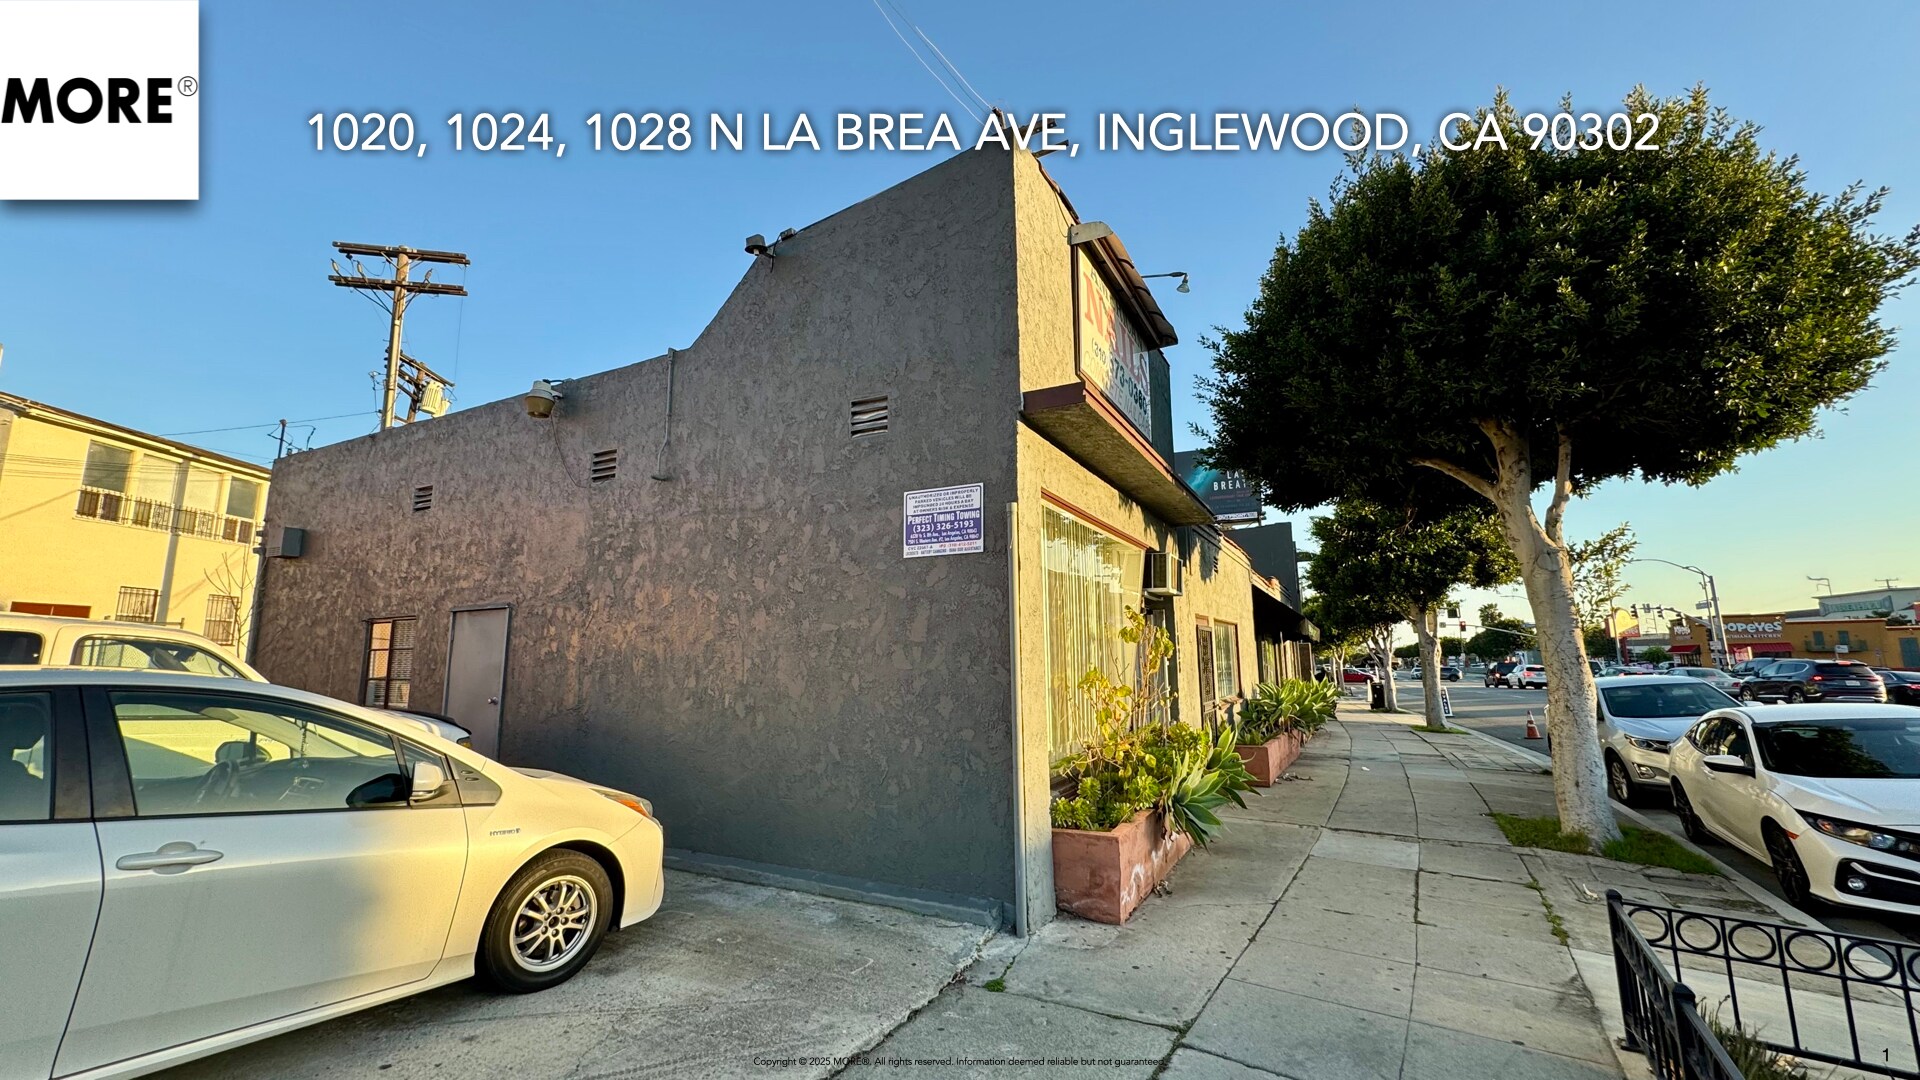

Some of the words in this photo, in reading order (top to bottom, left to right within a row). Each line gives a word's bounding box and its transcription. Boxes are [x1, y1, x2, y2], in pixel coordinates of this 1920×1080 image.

[1083, 271, 1150, 397] NAILS
[907, 515, 932, 525] PERFECT
[933, 513, 954, 522] TIMING
[956, 510, 980, 520] TOWING
[913, 524, 934, 533] (323)
[936, 520, 974, 531] 326-5193
